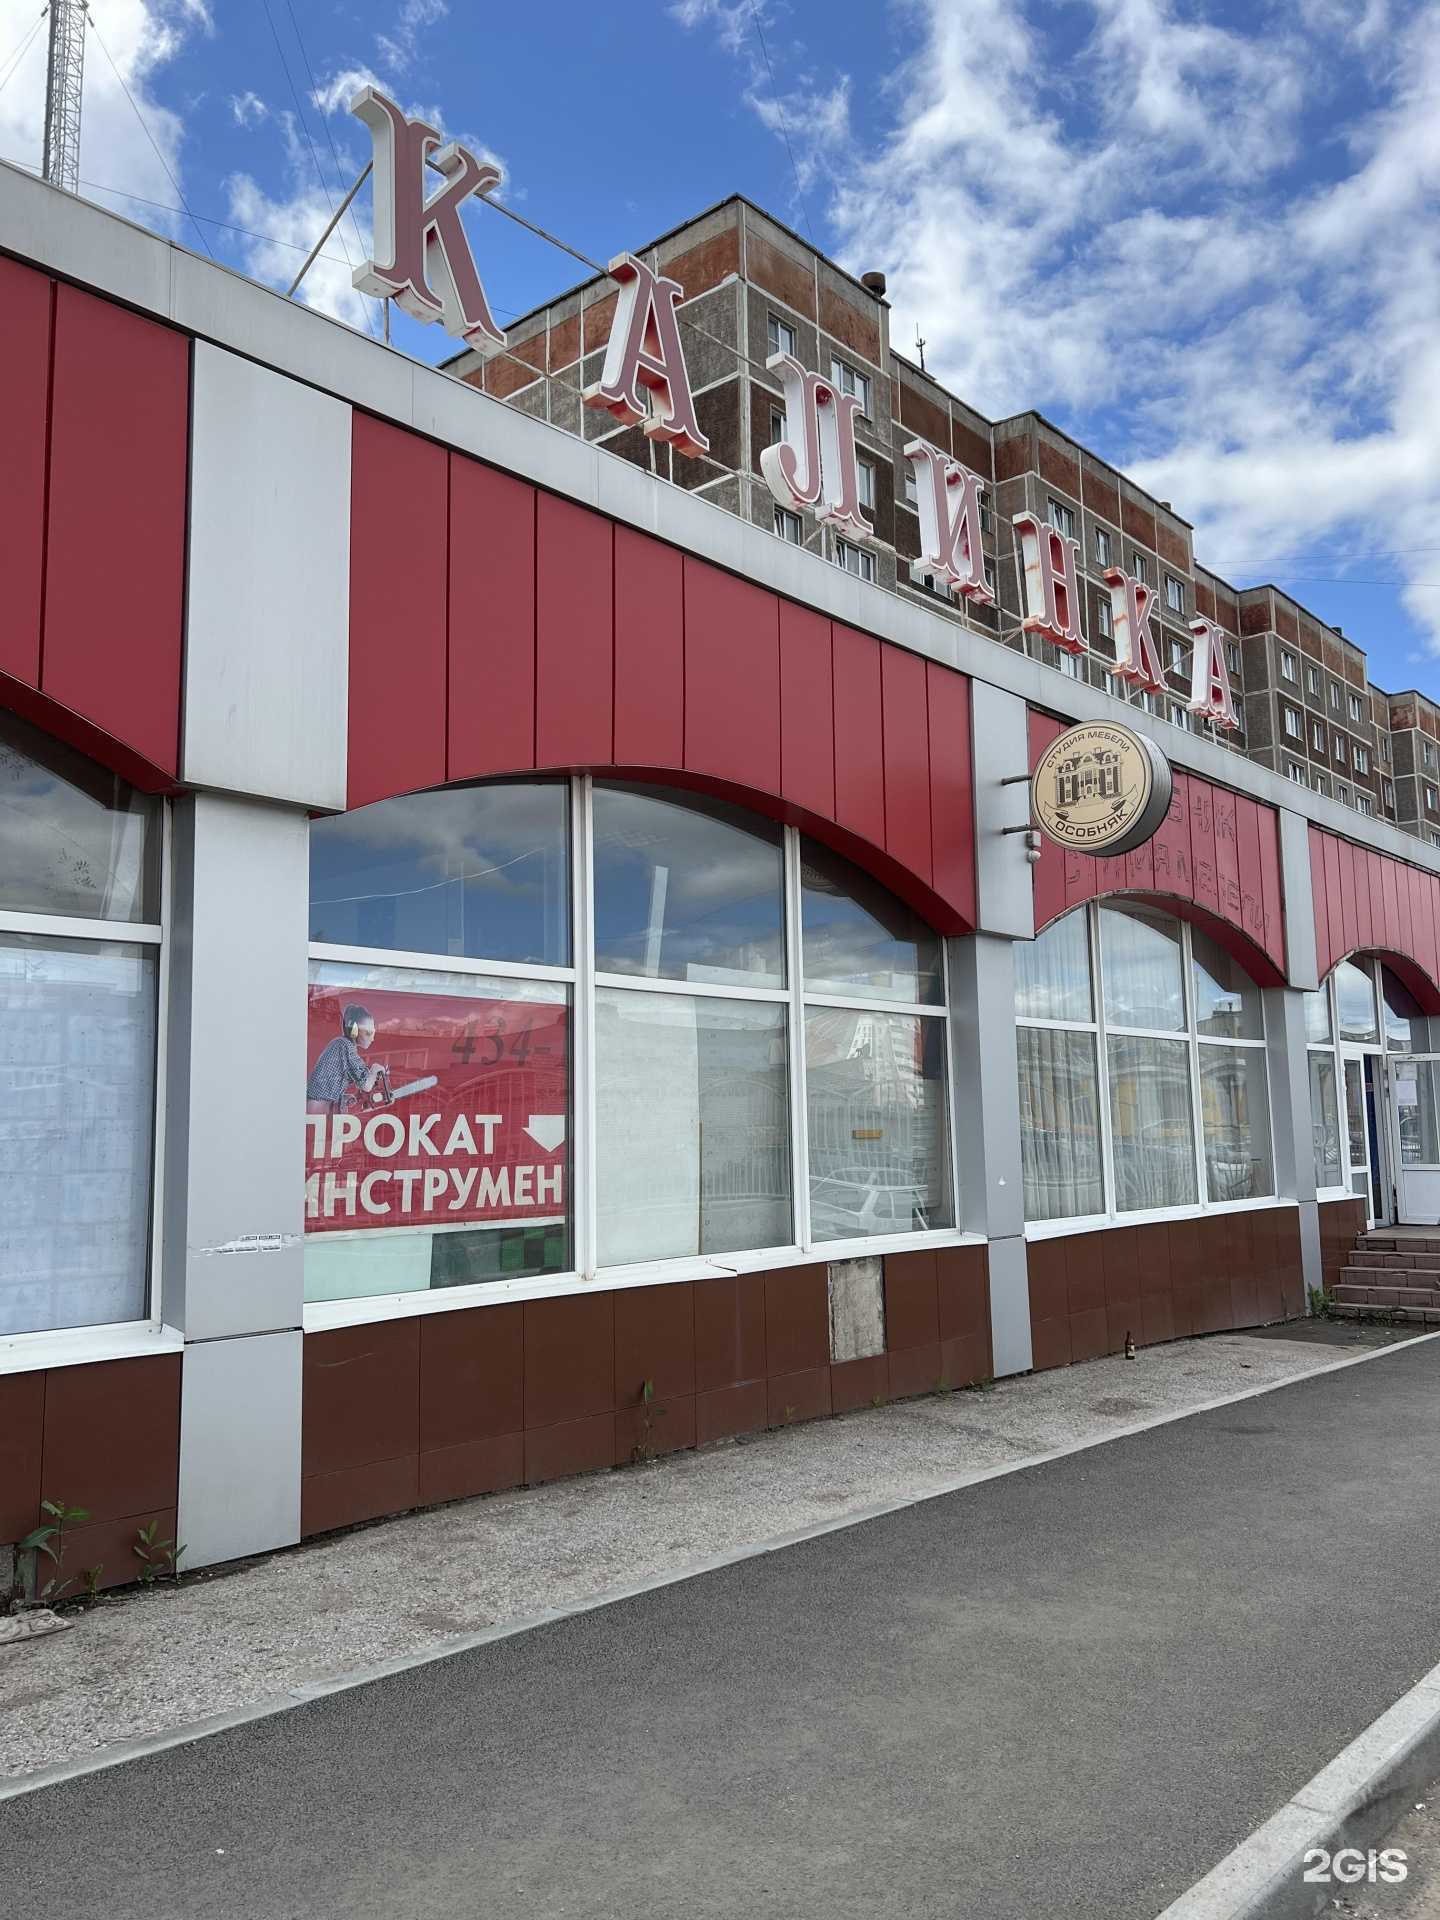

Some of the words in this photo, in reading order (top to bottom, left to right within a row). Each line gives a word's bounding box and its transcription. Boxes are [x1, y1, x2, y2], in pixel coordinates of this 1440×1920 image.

[351, 85, 1239, 729] КАЛИНКА
[1047, 734, 1085, 769] СТУДИЯ
[1088, 731, 1130, 753] МЕБЕЛИ
[1055, 810, 1128, 838] ОСОБНЯК
